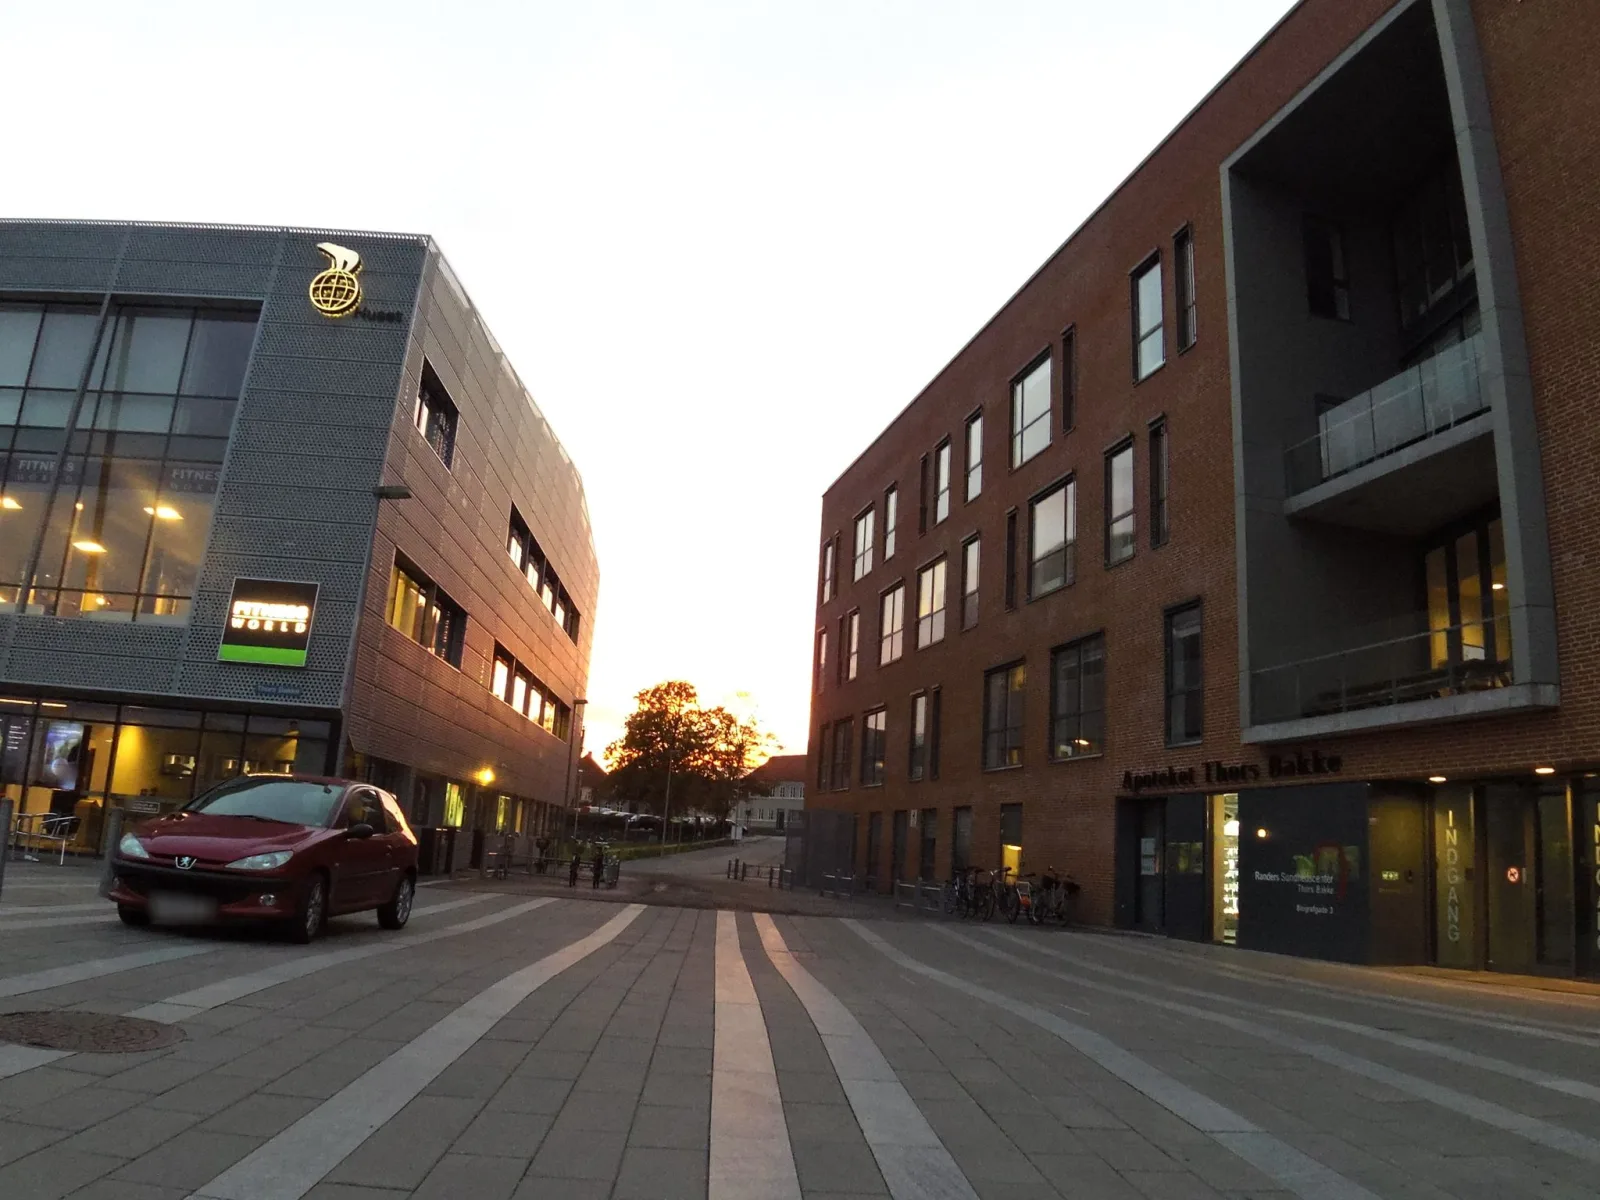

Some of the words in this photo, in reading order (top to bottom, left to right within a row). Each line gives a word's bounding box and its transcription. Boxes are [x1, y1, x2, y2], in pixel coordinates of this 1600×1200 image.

[19, 459, 75, 472] FITNES
[172, 467, 221, 481] FITNES
[231, 617, 306, 633] WORLD
[1122, 765, 1196, 793] Apoteket
[1202, 760, 1260, 784] Thors
[1268, 749, 1343, 779] Bakke
[1254, 871, 1280, 881] Randers
[1445, 809, 1461, 943] INDGANG
